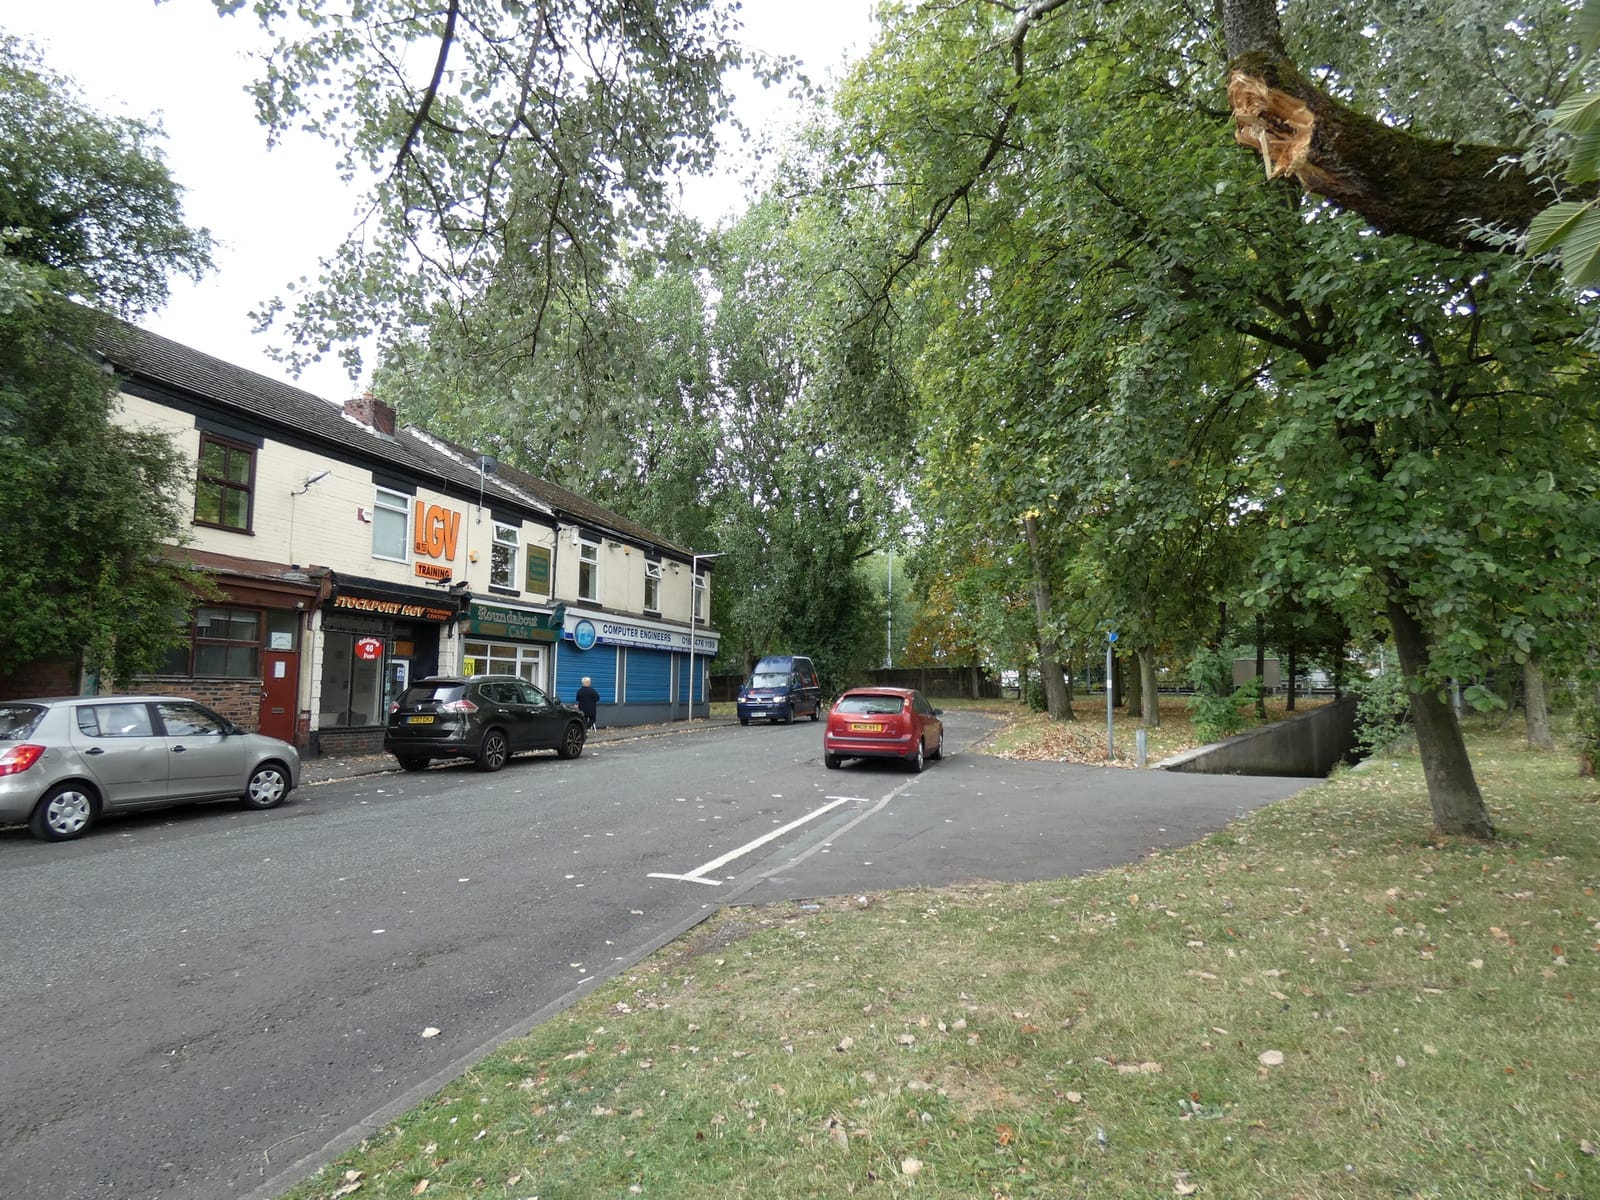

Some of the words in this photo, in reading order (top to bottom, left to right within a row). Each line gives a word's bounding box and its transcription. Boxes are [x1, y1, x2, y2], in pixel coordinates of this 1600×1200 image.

[414, 500, 461, 561] LGV
[418, 565, 450, 578] TRAINING
[334, 595, 401, 614] STOCKPORT
[401, 605, 425, 617] HGV
[477, 606, 538, 627] Roundabout
[603, 624, 639, 638] COMPUTER
[640, 630, 672, 642] ENGINEERS
[681, 636, 693, 646] 016
[365, 644, 374, 652] 40
